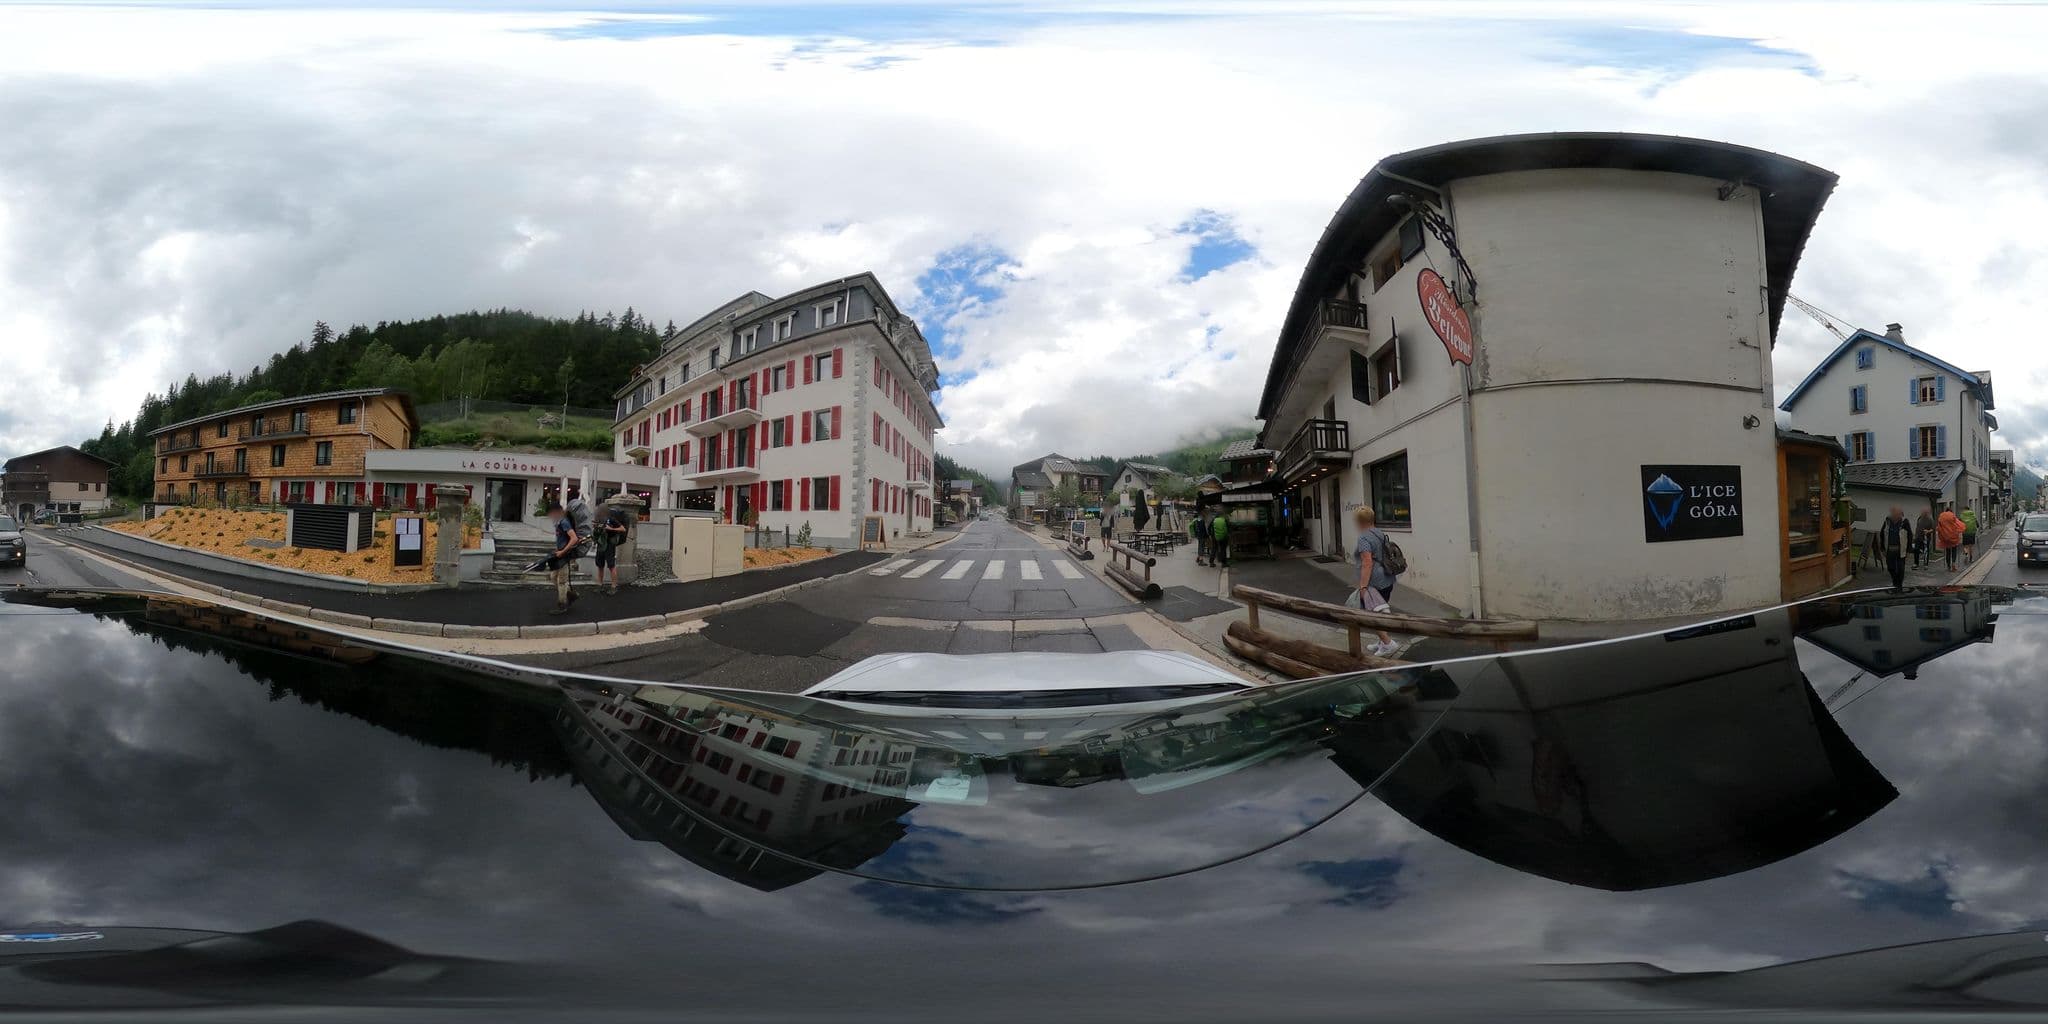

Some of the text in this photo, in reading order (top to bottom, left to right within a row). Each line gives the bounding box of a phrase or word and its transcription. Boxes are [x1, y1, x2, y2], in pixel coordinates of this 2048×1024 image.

[462, 461, 555, 473] LA COURONNE
[1690, 485, 1736, 498] L'ICE
[1690, 501, 1738, 518] GÓRA
